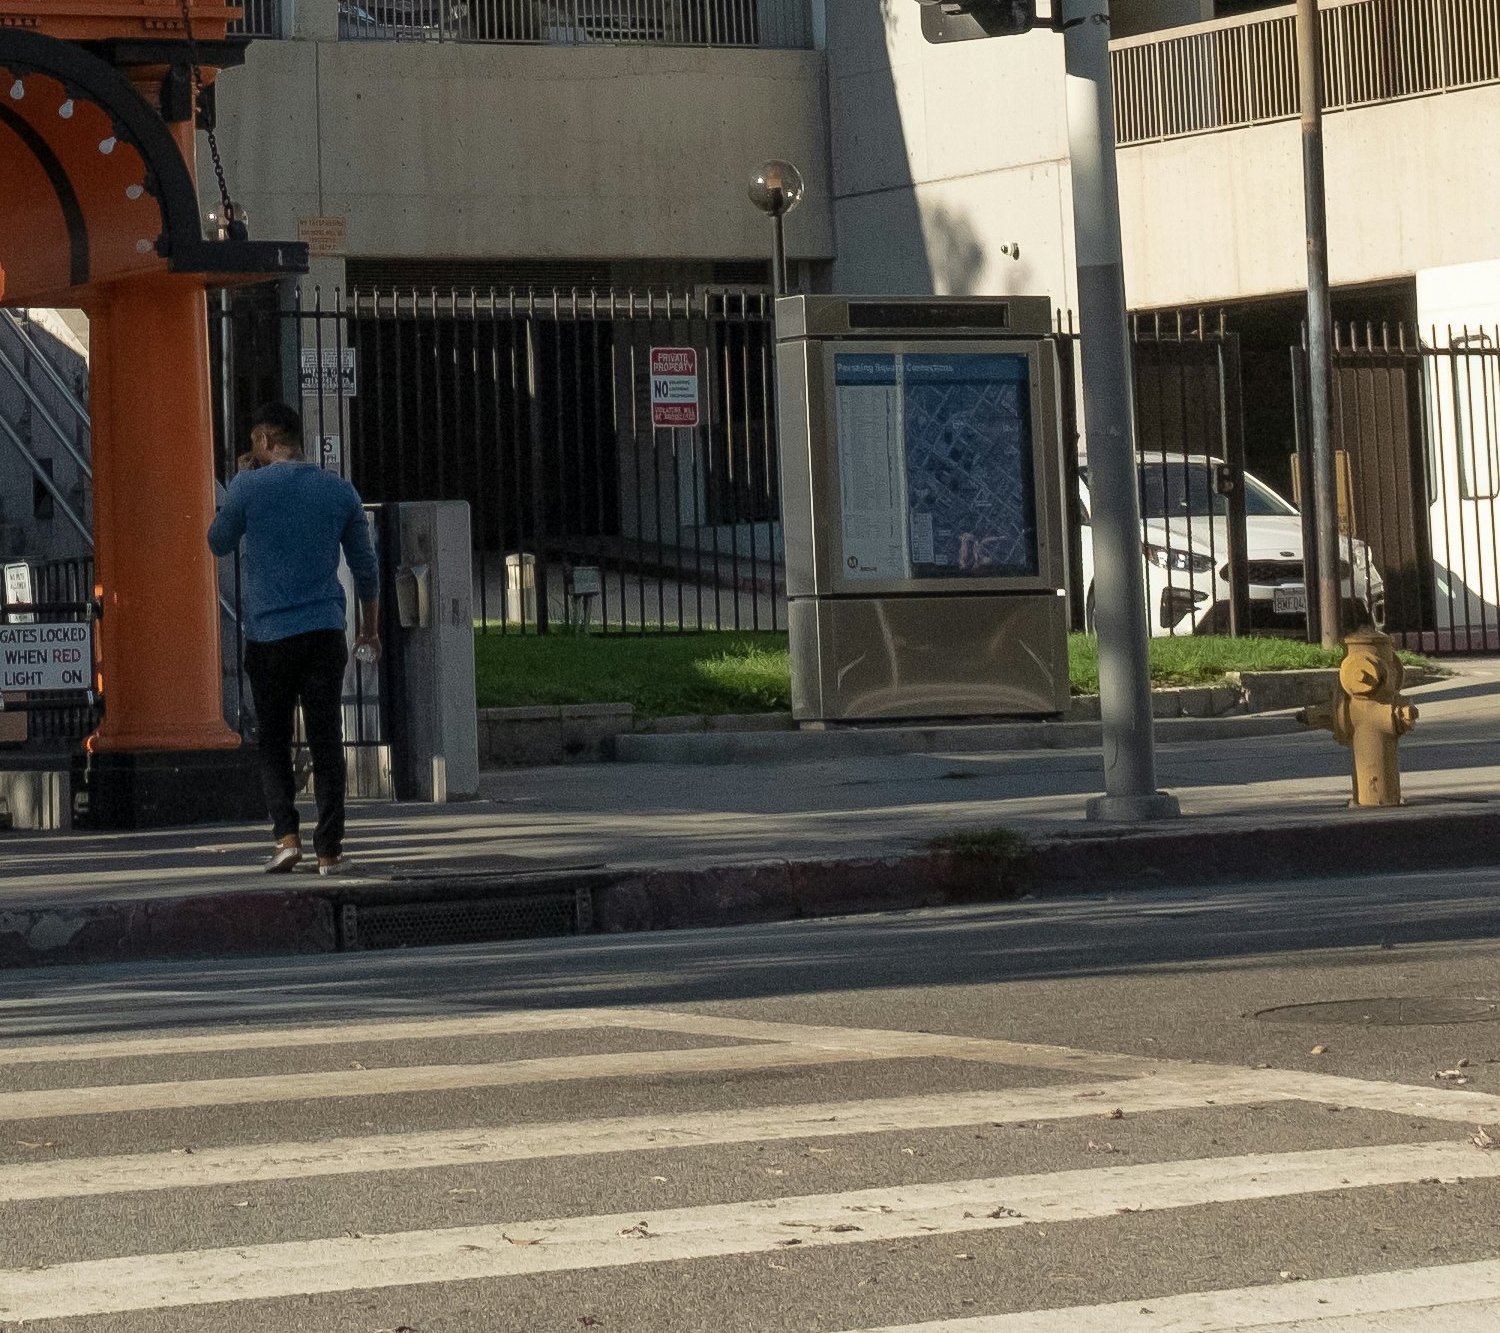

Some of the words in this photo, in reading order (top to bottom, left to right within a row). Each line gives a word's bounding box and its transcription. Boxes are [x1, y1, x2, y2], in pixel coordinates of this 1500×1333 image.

[657, 353, 688, 362] PRIVATE
[653, 362, 694, 372] PROPERTY
[654, 380, 669, 398] NO
[0, 628, 38, 643] GATES
[39, 627, 87, 643] LOCKED
[4, 649, 48, 665] WHEN
[52, 648, 82, 663] RED
[4, 671, 43, 686] LIGHT
[61, 670, 83, 684] ON
